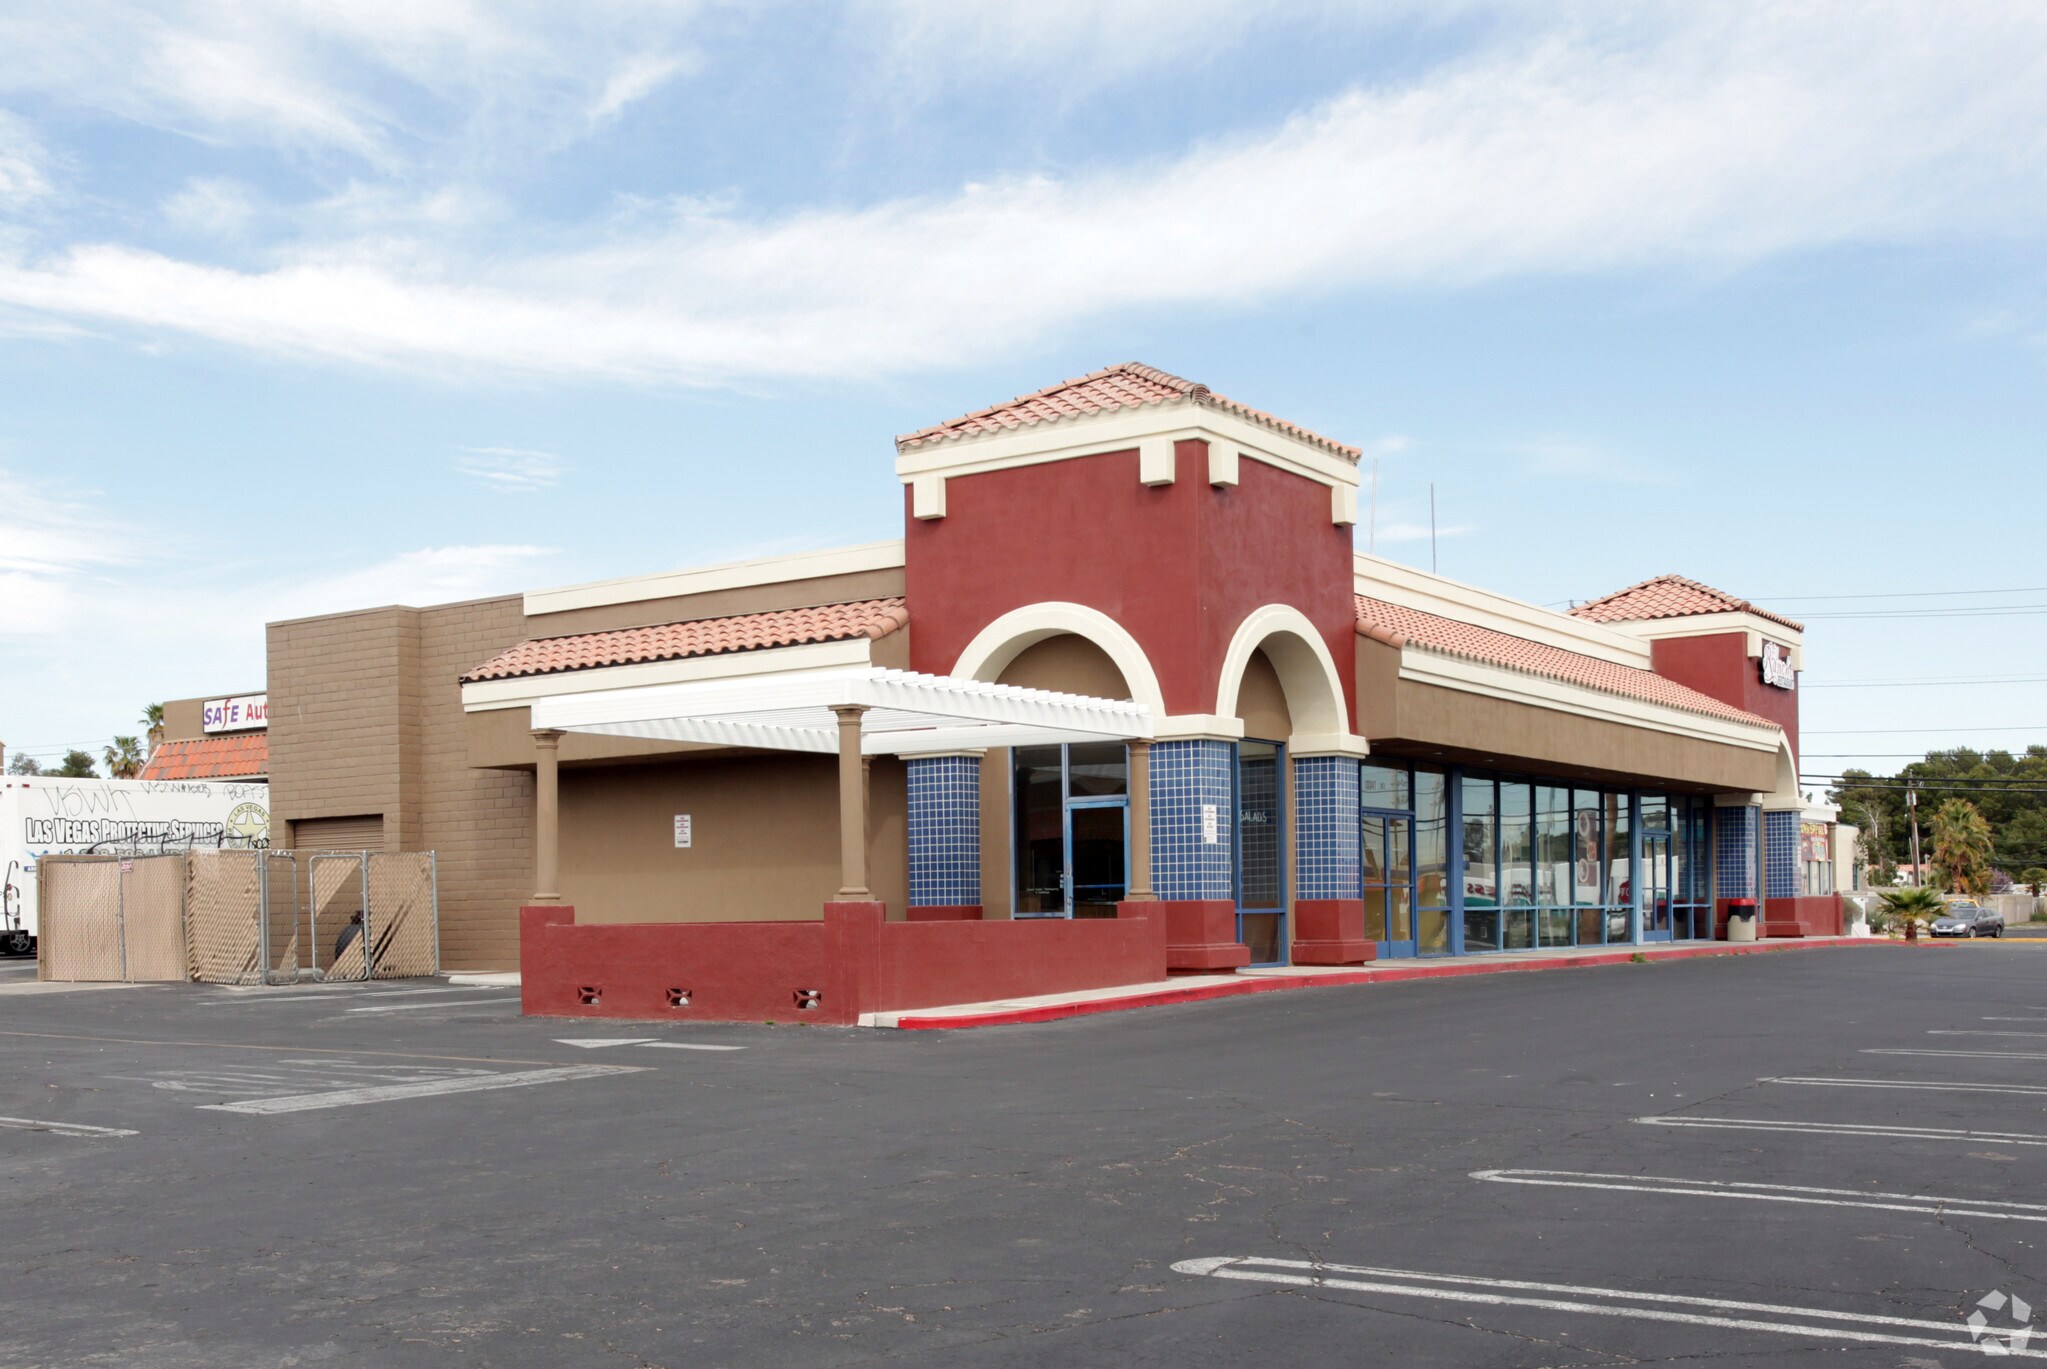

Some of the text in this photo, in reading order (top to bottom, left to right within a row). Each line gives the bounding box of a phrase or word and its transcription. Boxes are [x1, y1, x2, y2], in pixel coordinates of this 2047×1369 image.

[233, 804, 265, 816] LAS VEGAS
[25, 817, 54, 844] LAS
[53, 817, 101, 844] VEGAS
[100, 818, 170, 844] PROTECTIVE
